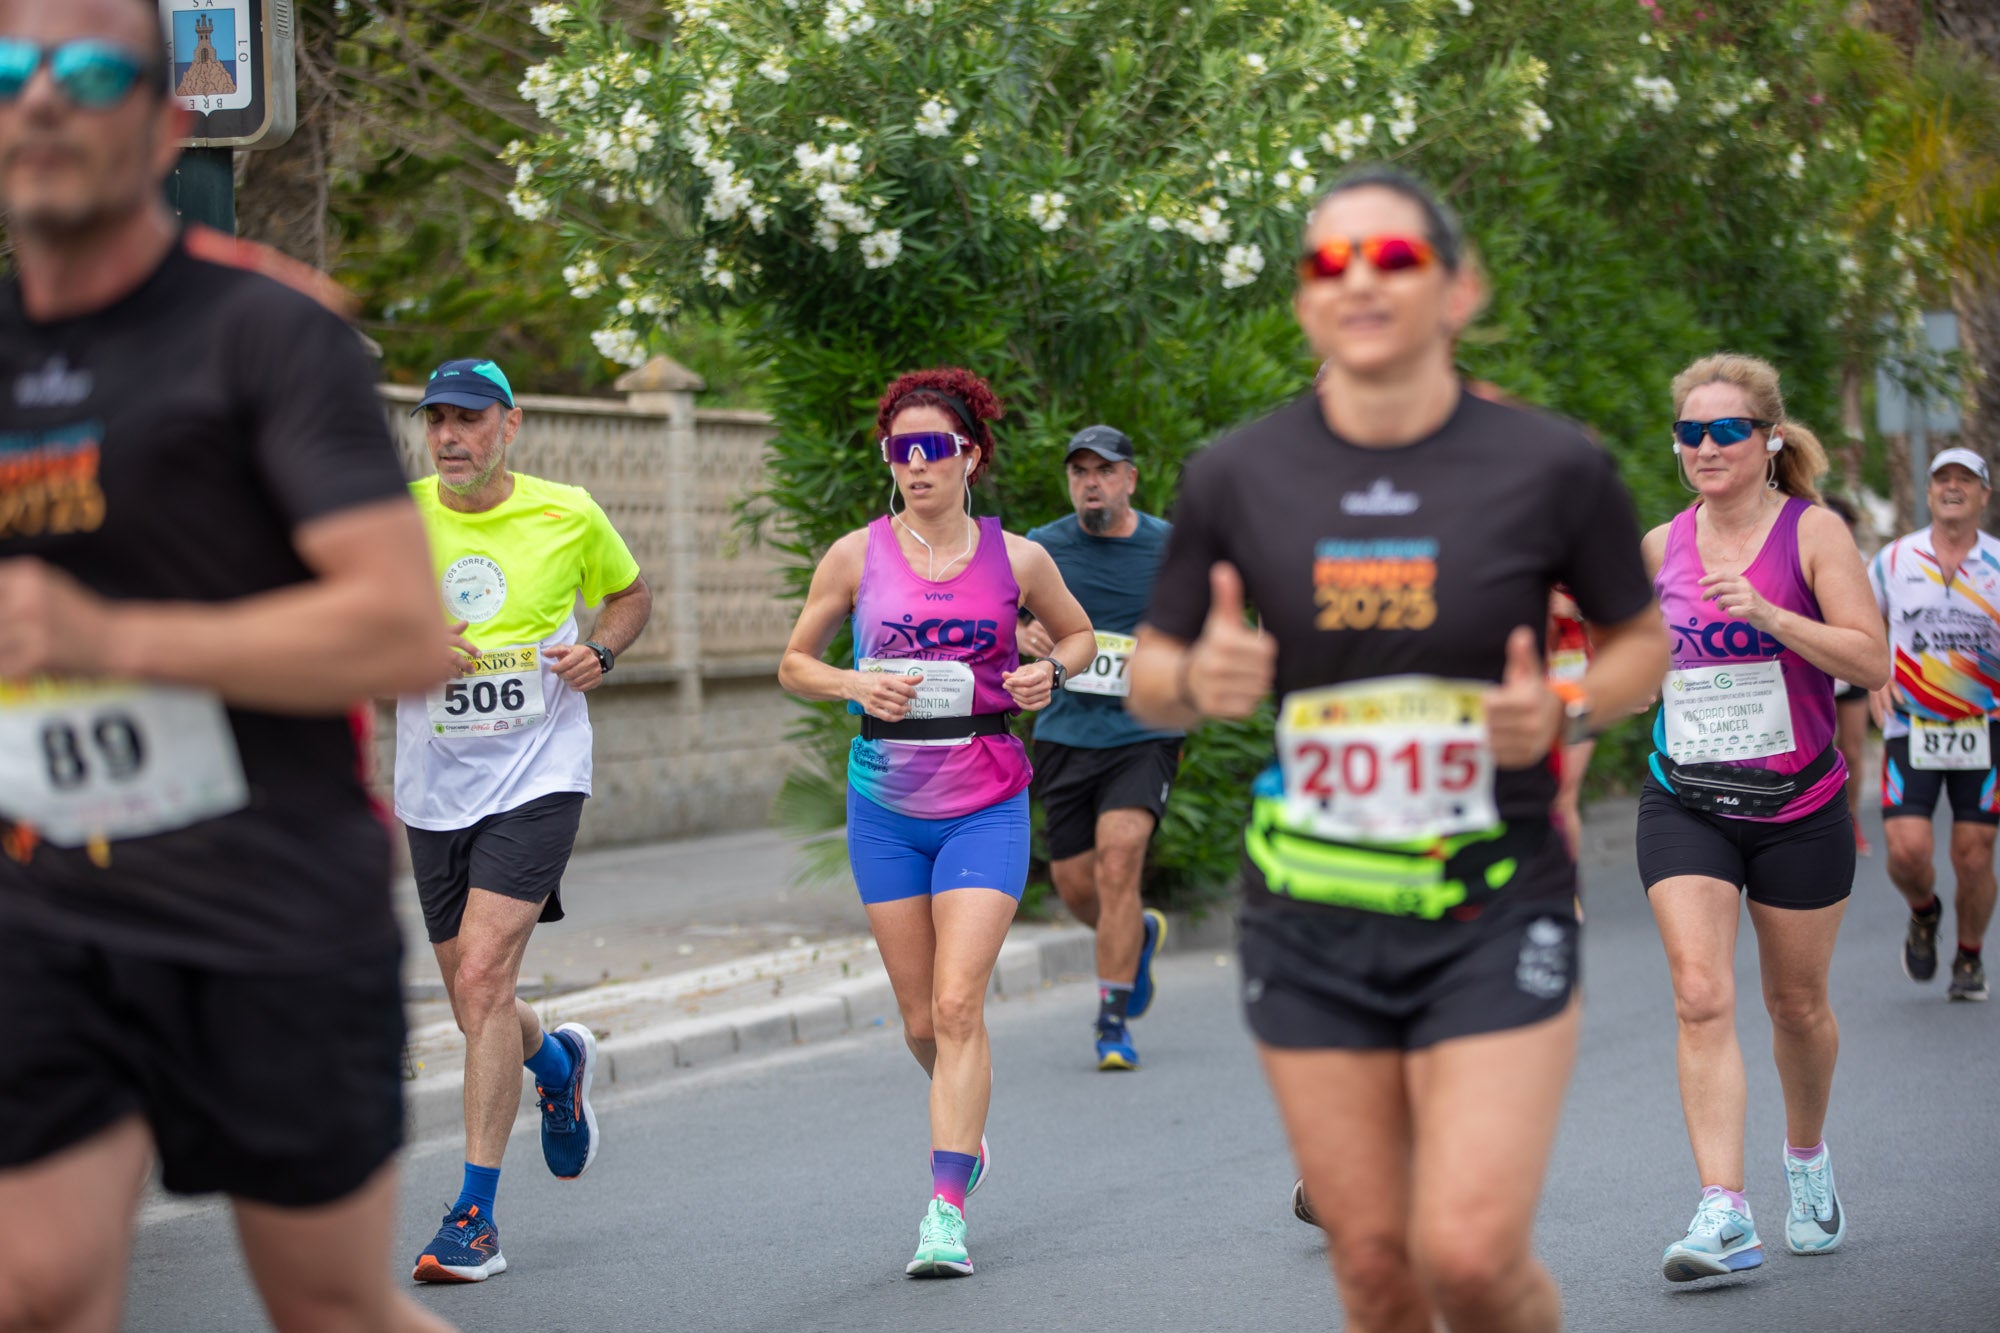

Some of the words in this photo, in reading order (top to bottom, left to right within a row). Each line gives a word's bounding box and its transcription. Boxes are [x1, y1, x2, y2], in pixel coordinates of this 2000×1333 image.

[447, 568, 457, 583] LOS
[457, 558, 485, 568] CORRE
[487, 561, 505, 588] BIRRAS
[925, 592, 954, 600] vive
[1314, 586, 1438, 631] 2025
[474, 657, 516, 671] ONDO
[444, 678, 525, 715] 506
[915, 699, 950, 709] CONTRA
[1727, 703, 1765, 717] CONTRA
[40, 713, 144, 791] 89
[1924, 732, 1976, 754] 870
[1294, 739, 1481, 797] 2015
[1716, 795, 1739, 806] FILA
